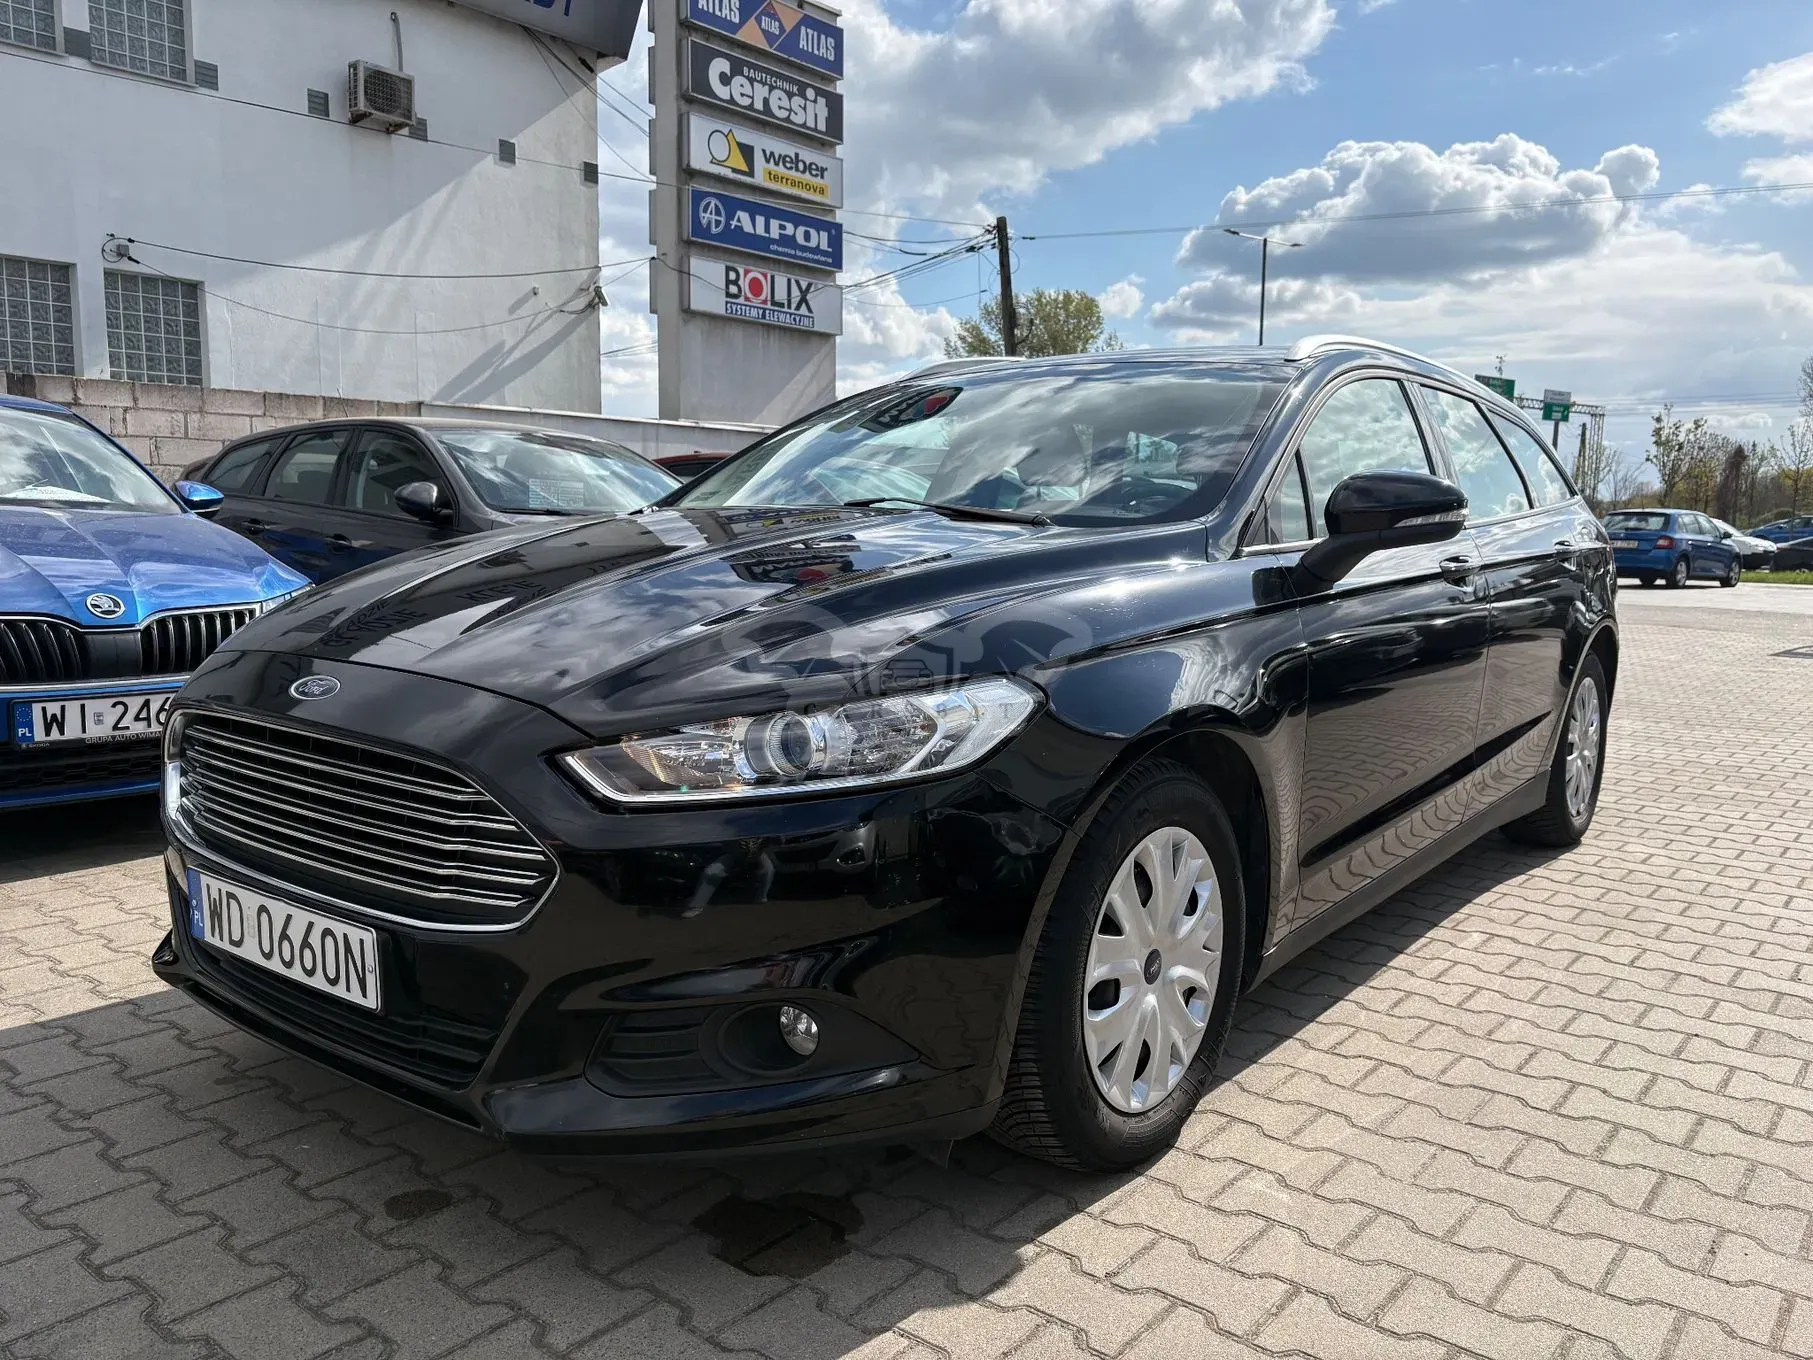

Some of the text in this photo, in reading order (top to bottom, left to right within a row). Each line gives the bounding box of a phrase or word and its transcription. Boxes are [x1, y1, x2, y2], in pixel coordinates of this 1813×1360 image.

[761, 15, 780, 35] ATLAS
[799, 26, 835, 61] ATLAS
[708, 57, 828, 132] Ceresit
[743, 66, 799, 94] BAUTECHNIK
[761, 148, 828, 180] weber
[768, 170, 825, 195] terranova
[730, 210, 832, 252] ALPOL
[769, 243, 833, 263] chemia budowlana
[725, 265, 814, 314] BOLIX
[726, 303, 814, 328] SYSTEMY ELEWACYJNE
[18, 727, 32, 738] PL
[41, 703, 87, 737] WI
[85, 731, 164, 744] GRUPA AUTO WIMA
[206, 883, 368, 999] WD 0660N
